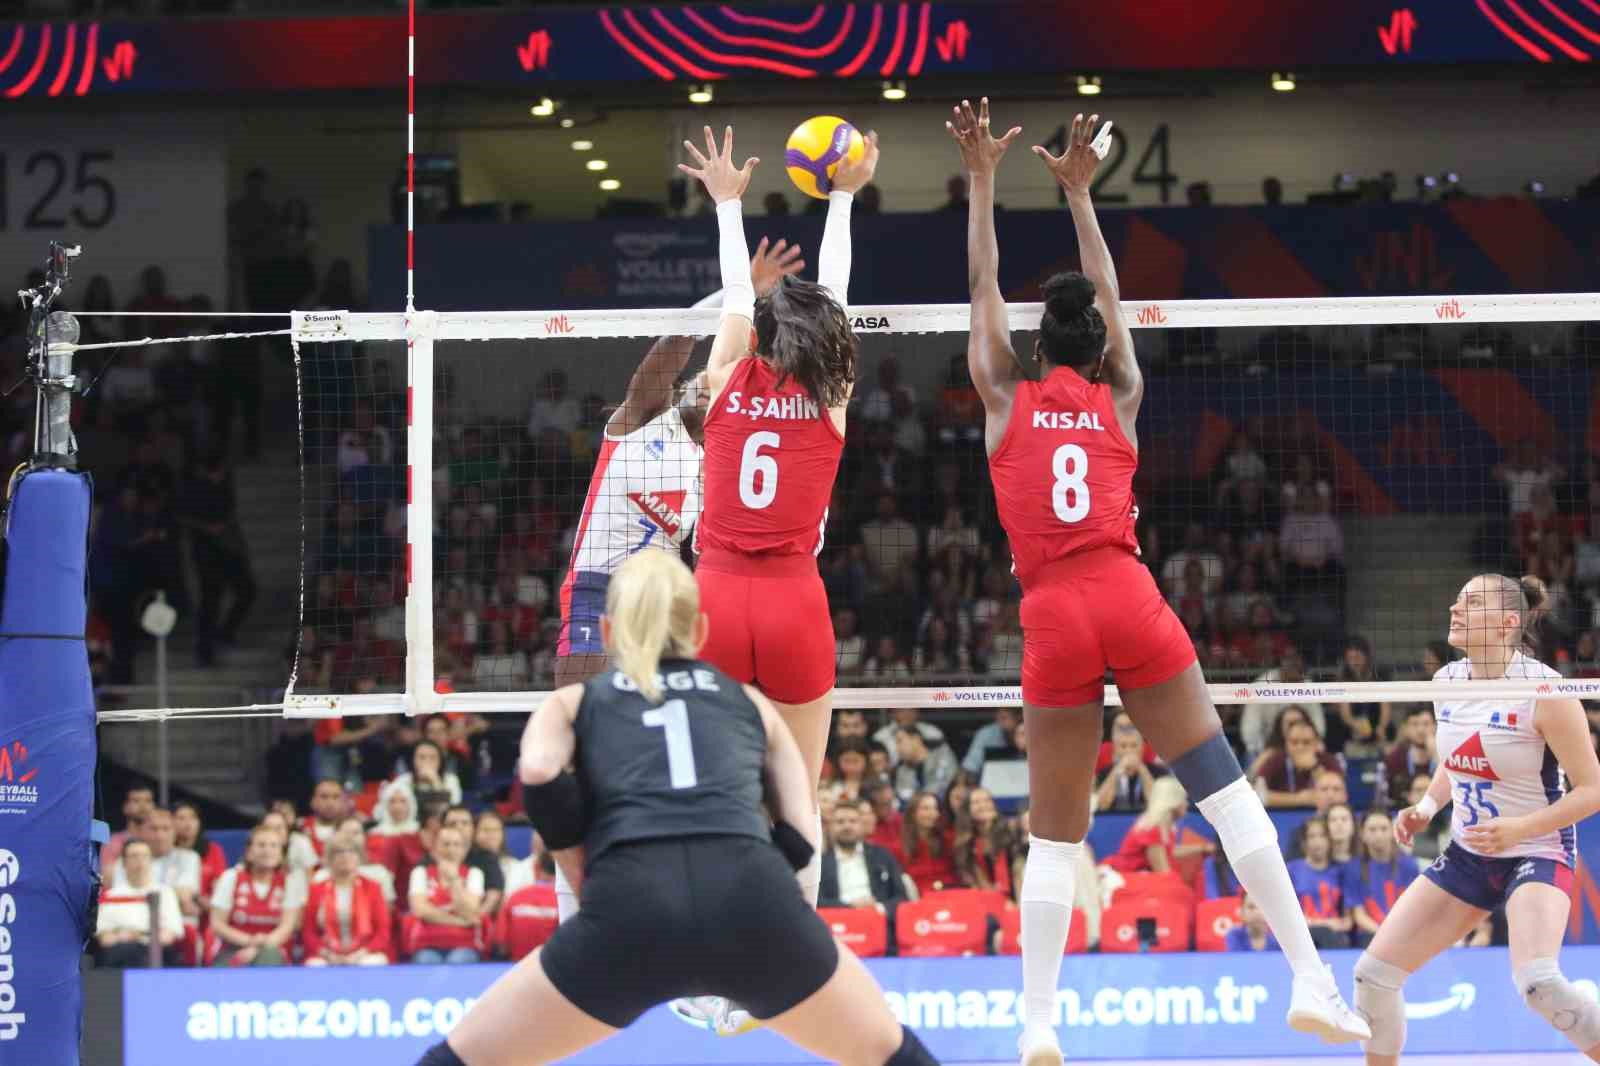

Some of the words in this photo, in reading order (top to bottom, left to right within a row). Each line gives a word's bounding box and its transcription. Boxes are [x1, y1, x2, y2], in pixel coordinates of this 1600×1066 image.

[312, 314, 341, 322] Senoh
[849, 316, 890, 329] ASA
[1032, 410, 1105, 431] KISAL
[739, 430, 780, 510] 6
[1051, 443, 1091, 523] 8
[580, 626, 591, 641] 7
[954, 691, 1024, 701] VOLLEYBALL
[1255, 688, 1322, 697] VOLLEYBALL
[641, 698, 698, 790] 1
[1448, 754, 1490, 772] MAIF
[1457, 781, 1500, 827] 35
[883, 976, 1268, 1028] amazn.com.tr
[186, 997, 480, 1040] amazon.co
